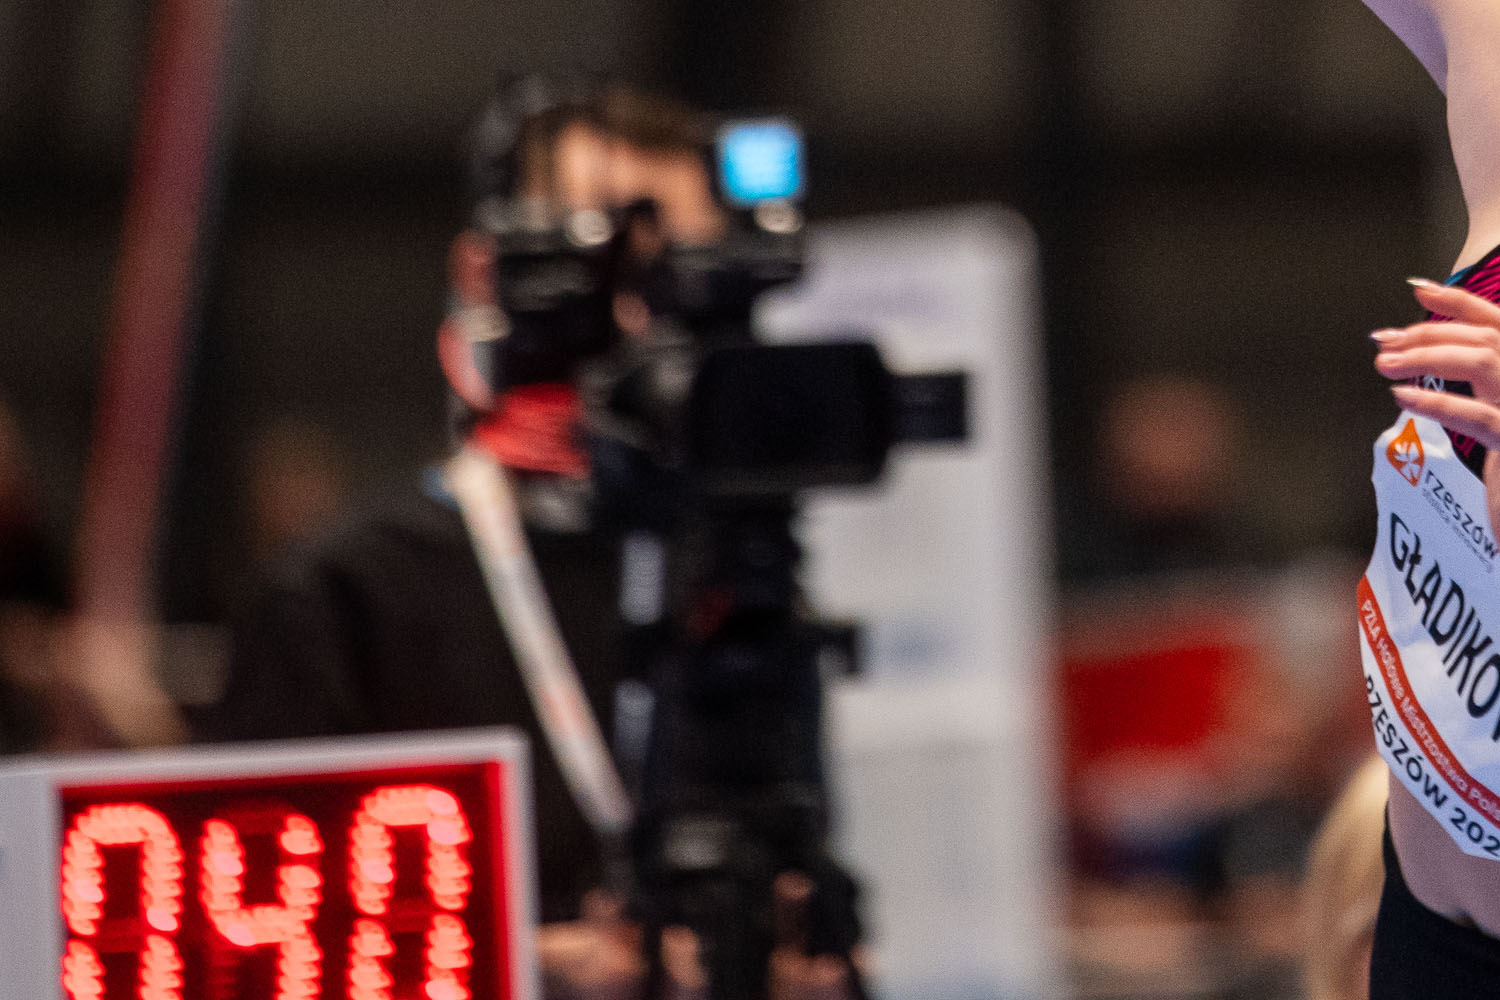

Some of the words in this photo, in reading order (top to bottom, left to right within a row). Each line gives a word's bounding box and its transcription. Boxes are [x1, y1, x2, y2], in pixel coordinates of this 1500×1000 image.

[1425, 469, 1498, 558] rzeszów
[1377, 637, 1405, 699] Halowe
[1400, 697, 1468, 792] Mistrzostwa
